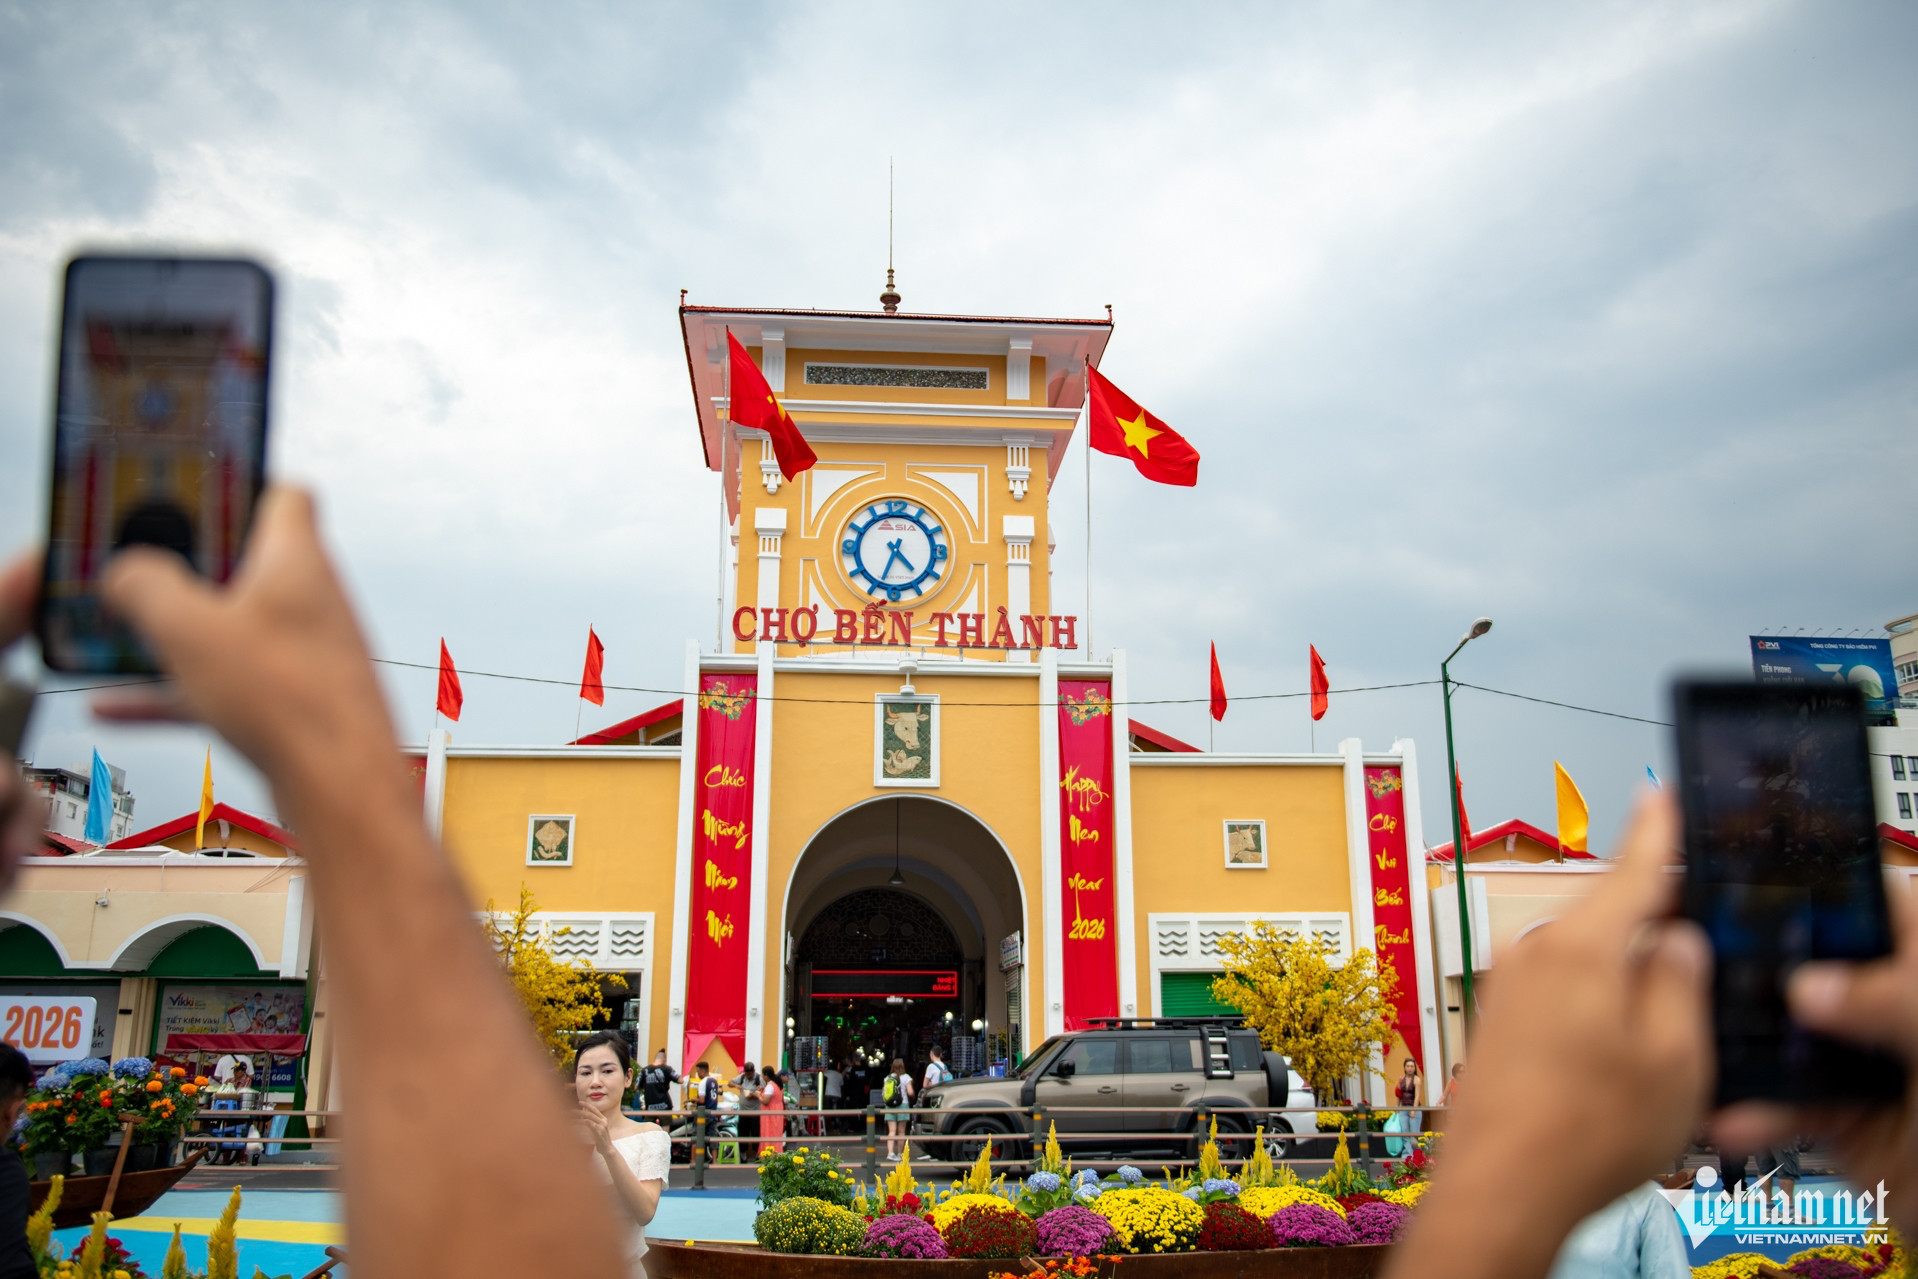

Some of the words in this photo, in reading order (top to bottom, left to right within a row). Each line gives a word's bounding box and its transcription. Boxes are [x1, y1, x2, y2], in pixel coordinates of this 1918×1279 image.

[885, 501, 907, 515] 12
[842, 539, 857, 555] 9
[933, 544, 948, 560] 3
[887, 586, 901, 601] 6
[732, 603, 818, 648] CHỢ
[833, 599, 914, 646] BẾN
[929, 606, 1078, 650] THÀNH
[704, 764, 746, 787] Chúc
[1060, 764, 1109, 812] Happy
[702, 809, 751, 849] Mừng
[1069, 814, 1099, 847] New
[1368, 813, 1397, 834] Chợ
[1375, 847, 1397, 870] Vui
[705, 859, 738, 892] Năm
[1068, 872, 1105, 920] Year
[1374, 887, 1404, 907] Bến
[705, 909, 734, 948] Mới
[1068, 917, 1105, 940] 2026
[1374, 924, 1410, 950] Thành
[169, 992, 195, 1006] Vikki
[3, 1005, 83, 1049] 2026
[271, 1073, 292, 1081] 6608
